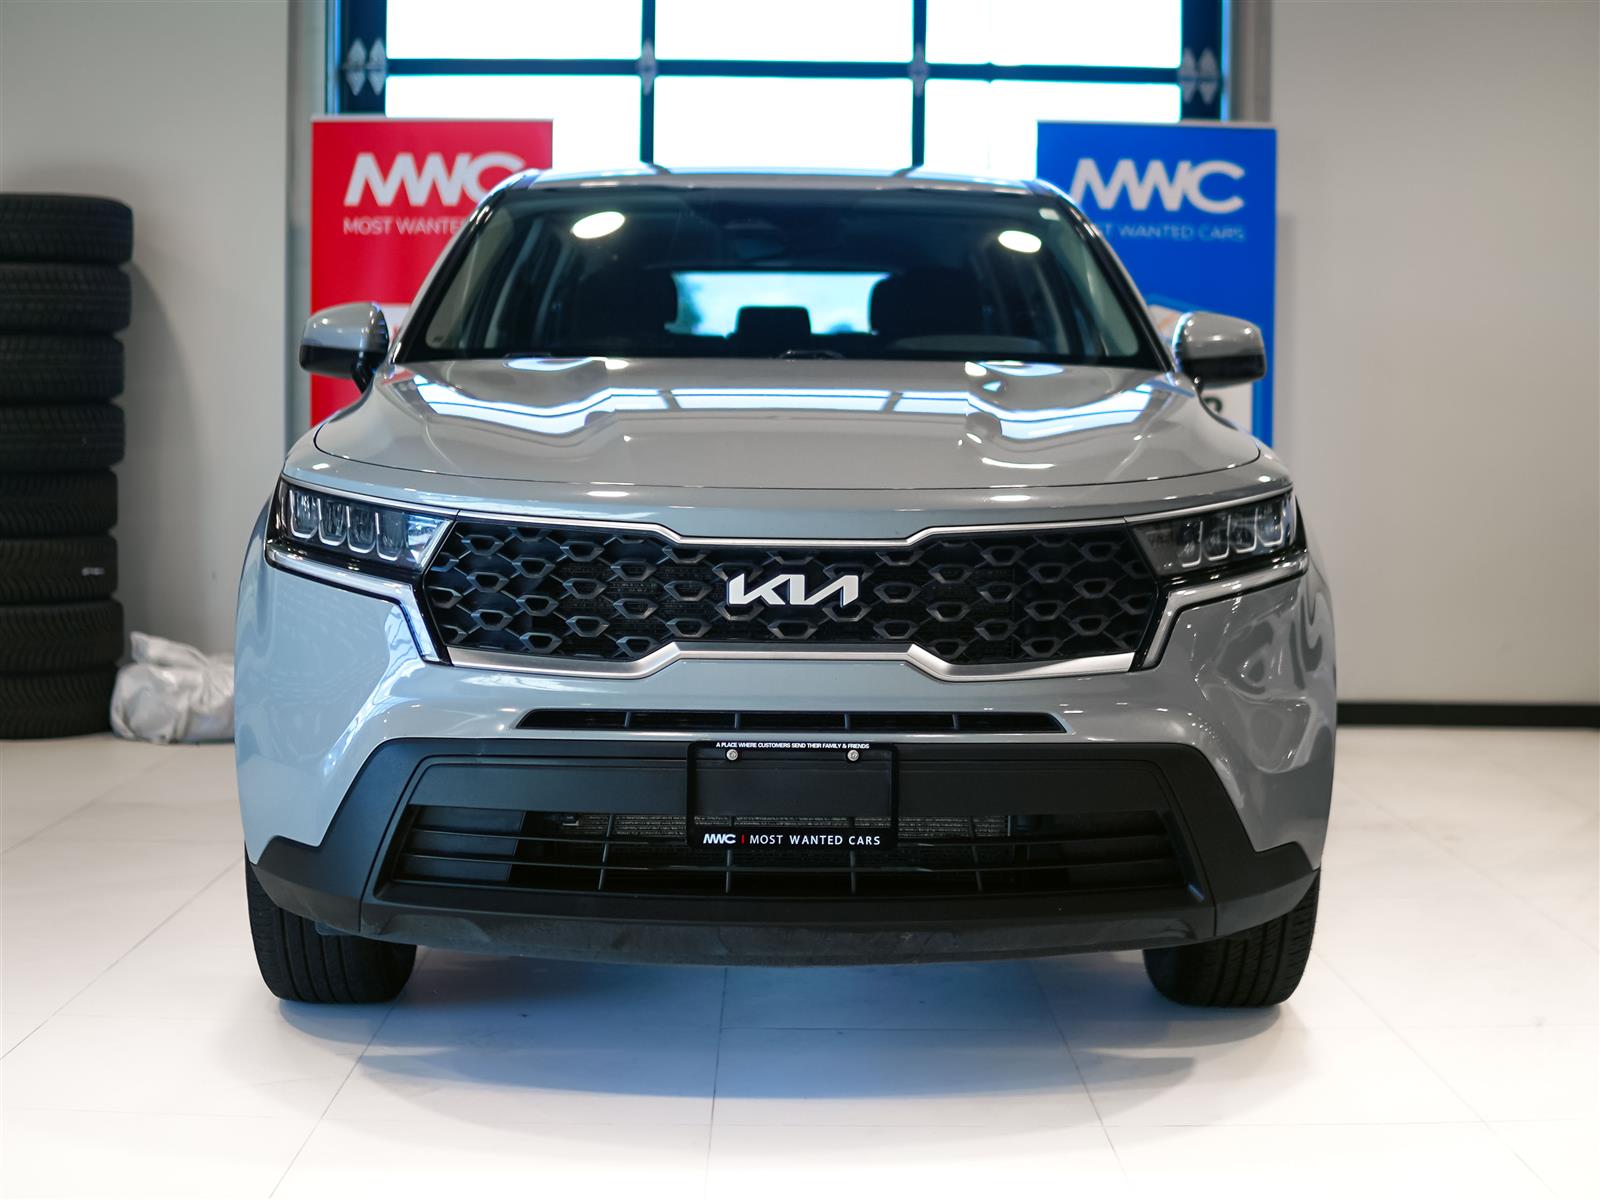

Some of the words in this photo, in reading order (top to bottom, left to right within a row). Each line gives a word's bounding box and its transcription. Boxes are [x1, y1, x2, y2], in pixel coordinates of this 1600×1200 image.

[343, 152, 526, 207] MWC
[1069, 158, 1245, 213] MWC
[343, 217, 392, 235] MOST
[396, 217, 465, 235] WANTE
[1119, 224, 1193, 240] WANTED
[1198, 225, 1245, 242] CARS
[727, 573, 859, 607] KIA
[703, 833, 737, 844] MWC
[749, 834, 784, 845] MOST
[789, 834, 843, 846] WANTED
[848, 835, 881, 846] CARS
